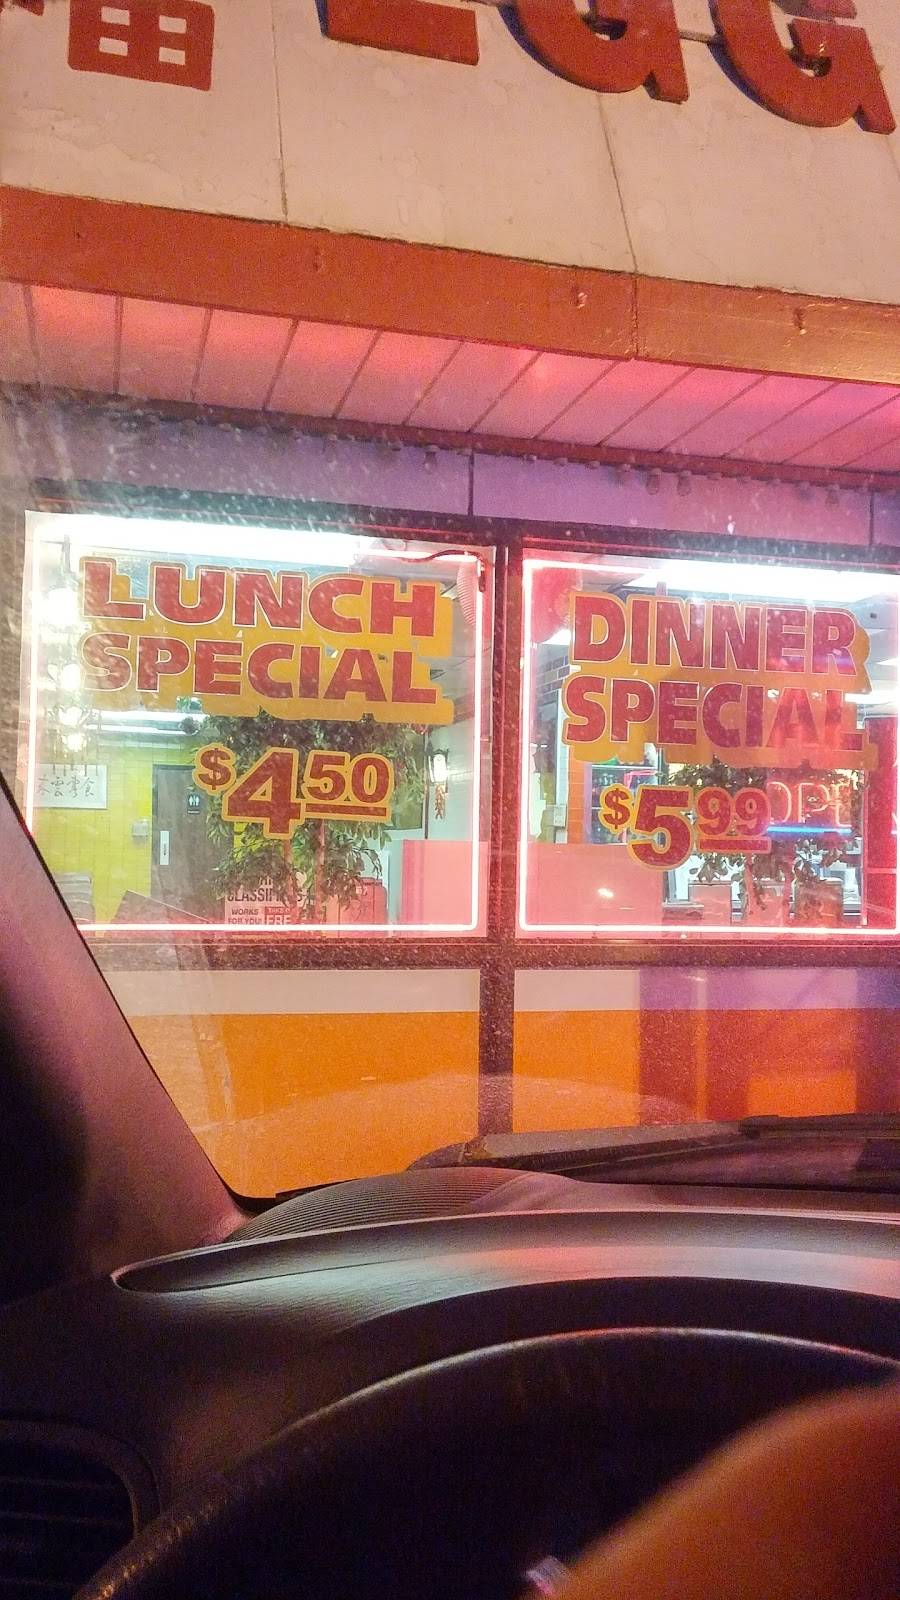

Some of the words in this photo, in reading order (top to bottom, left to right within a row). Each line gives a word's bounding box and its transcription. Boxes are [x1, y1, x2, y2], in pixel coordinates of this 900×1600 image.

[82, 559, 437, 637] LUNCH
[572, 594, 858, 676] DINNER
[80, 632, 437, 704] SPECIAL
[565, 674, 865, 751] SPECIAL
[231, 908, 260, 916] WORKS
